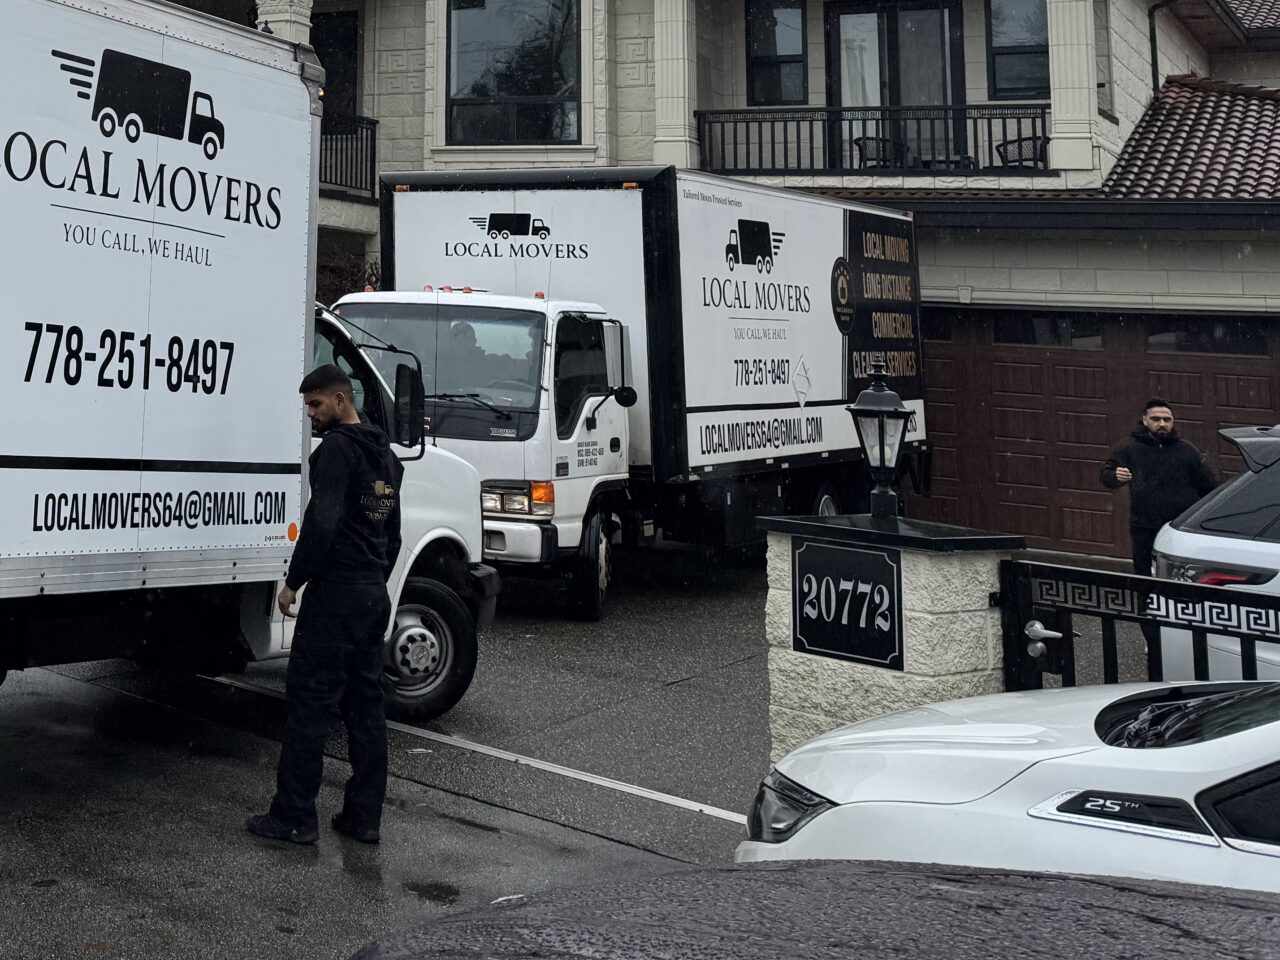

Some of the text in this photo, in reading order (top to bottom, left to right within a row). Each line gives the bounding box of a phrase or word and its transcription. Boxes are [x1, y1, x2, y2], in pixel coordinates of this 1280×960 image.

[132, 158, 282, 230] MOVERS
[63, 223, 212, 267] YOU CALL, WE HAUL
[444, 242, 589, 260] LOCAL MOVERS
[863, 231, 910, 263] LOCAL MOVING
[702, 277, 811, 314] LOCAL MOVERS
[863, 272, 912, 301] LONG DISTANCE
[733, 327, 745, 340] YOU
[763, 327, 771, 340] WE
[772, 328, 787, 340] HAUL
[872, 311, 914, 339] COMMERCIAL
[23, 321, 235, 395] 778-251-8497
[734, 358, 790, 386] 778-251-8497
[853, 351, 917, 379] CLEANG SERVICES
[700, 416, 823, 455] LOCALMOVERS64@GMAIL.COM
[32, 490, 286, 532] LOCALMOVERS64@GMAIL.COM
[802, 573, 891, 632] 20772
[1084, 797, 1140, 812] 25TH
